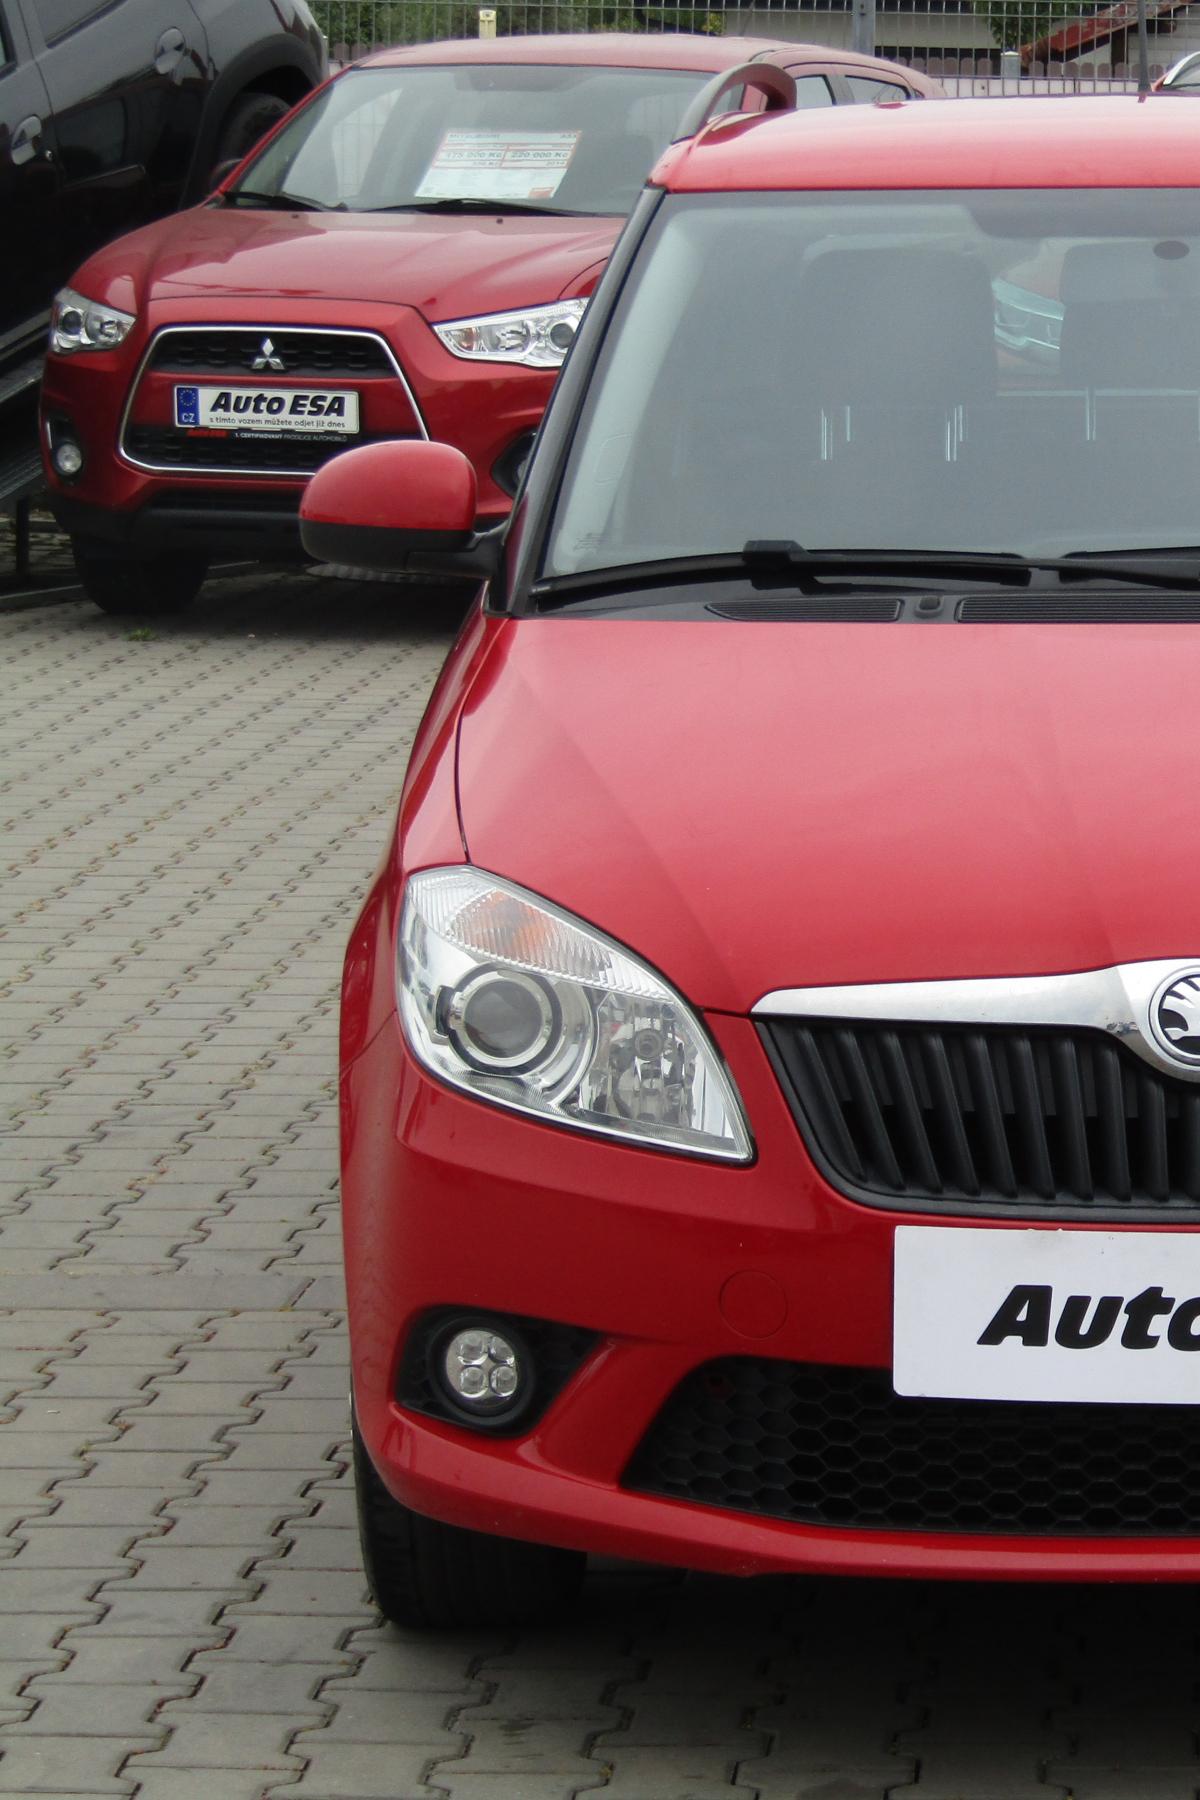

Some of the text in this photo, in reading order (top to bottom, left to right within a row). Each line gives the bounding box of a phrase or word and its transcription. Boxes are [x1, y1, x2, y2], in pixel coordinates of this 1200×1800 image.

[511, 151, 531, 159] 220
[532, 151, 553, 159] 000
[210, 391, 346, 417] Auto ESA
[181, 412, 196, 423] CZ
[238, 417, 263, 425] vozem
[264, 416, 293, 426] můžete
[294, 417, 315, 428] odjet
[327, 418, 346, 428] dnes
